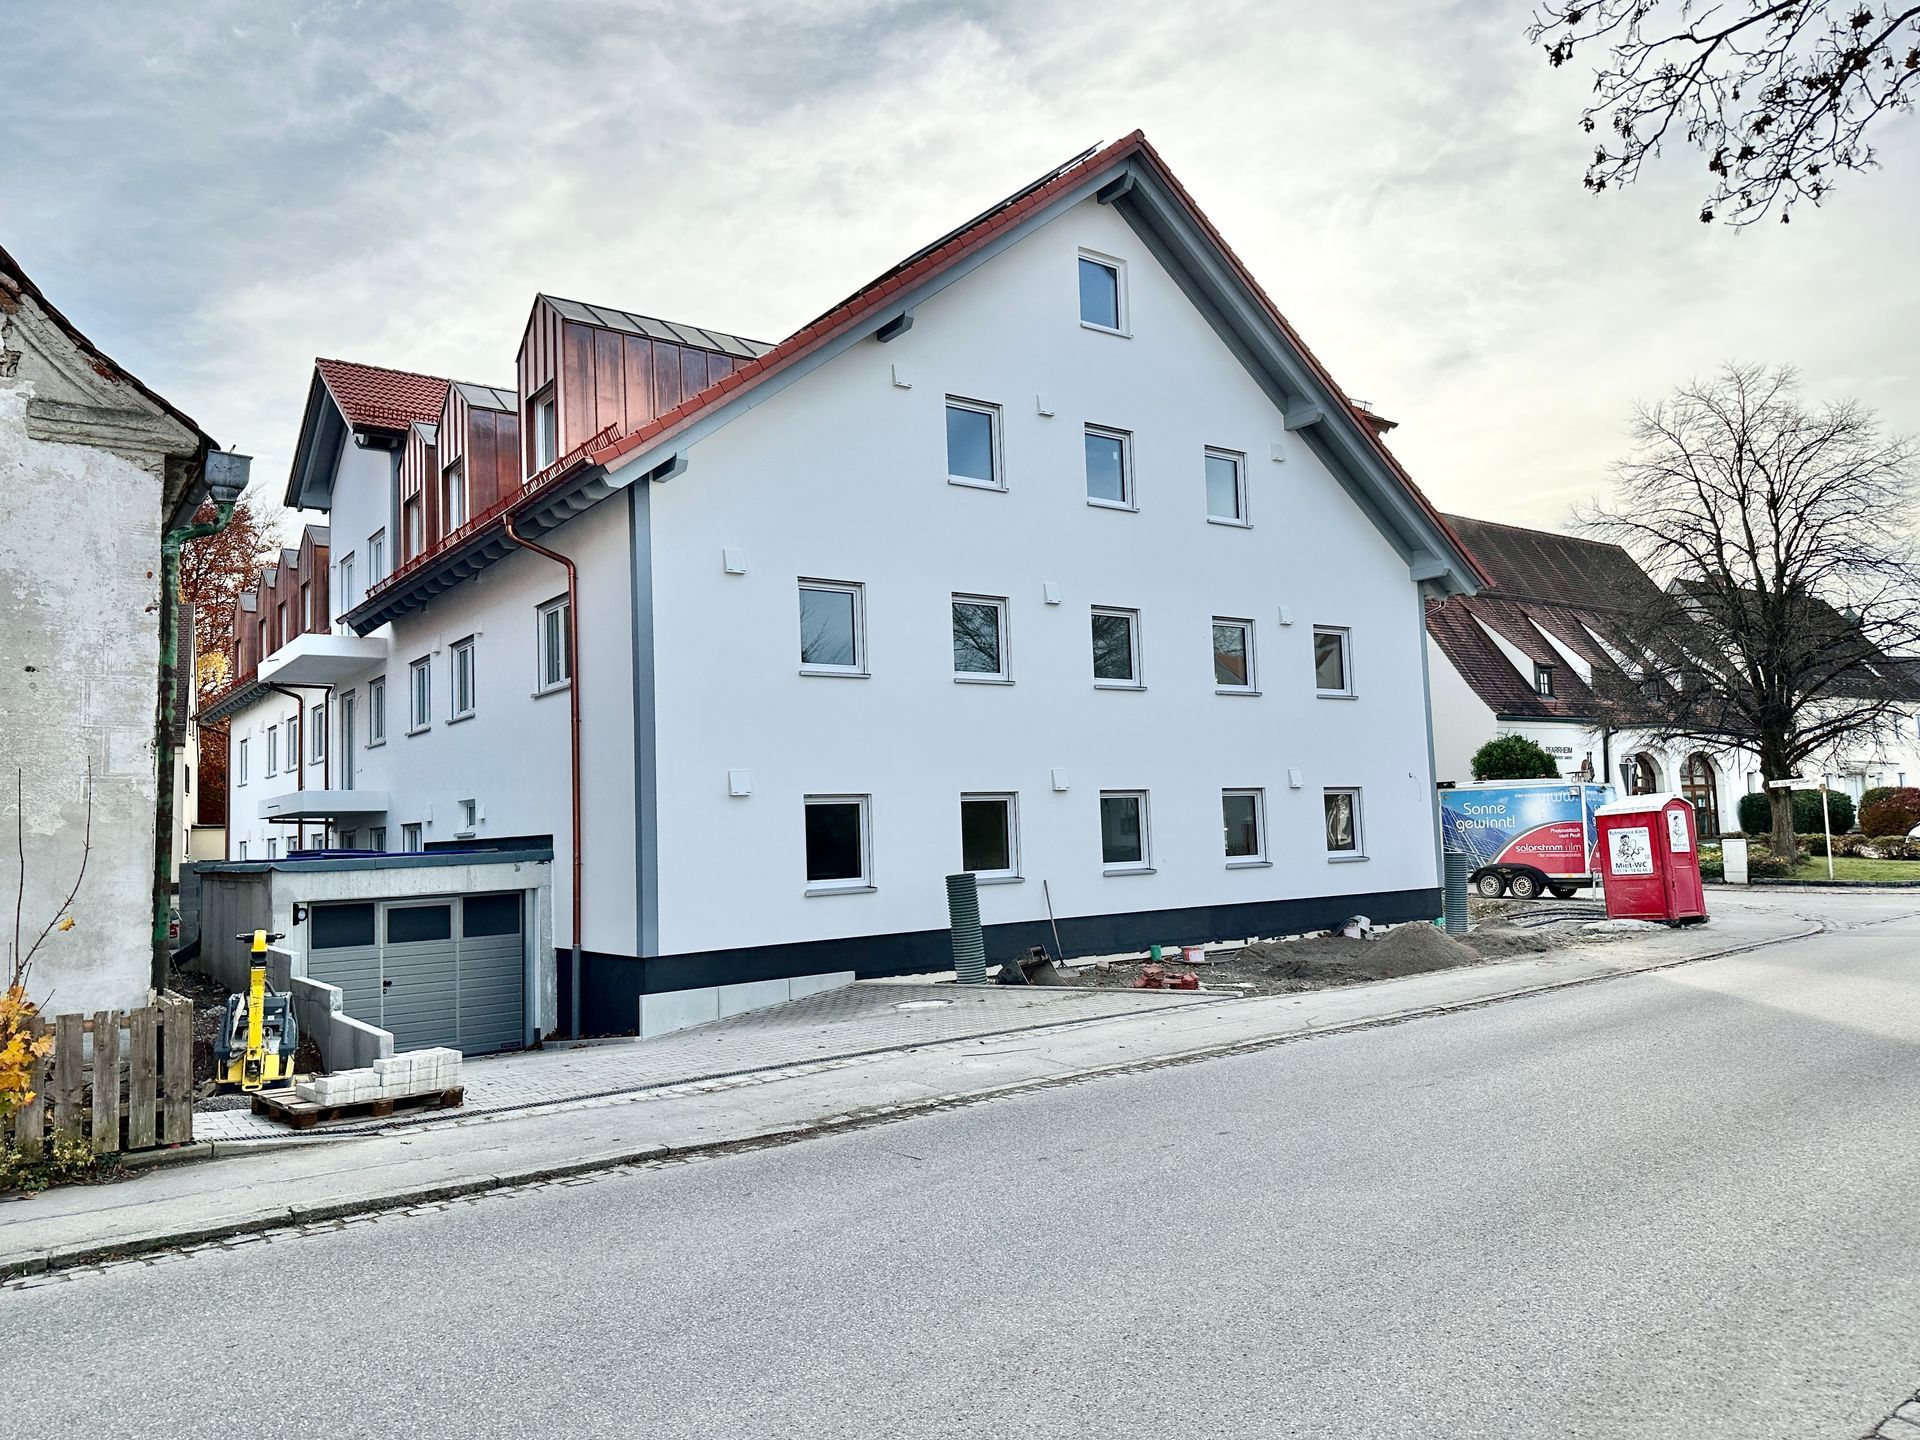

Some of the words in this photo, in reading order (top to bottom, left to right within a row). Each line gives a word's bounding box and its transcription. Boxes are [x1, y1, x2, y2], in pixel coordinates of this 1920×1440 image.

[1463, 802, 1506, 816] Sonne
[1455, 815, 1516, 833] gewinnt!
[1515, 843, 1563, 852] solarstrom
